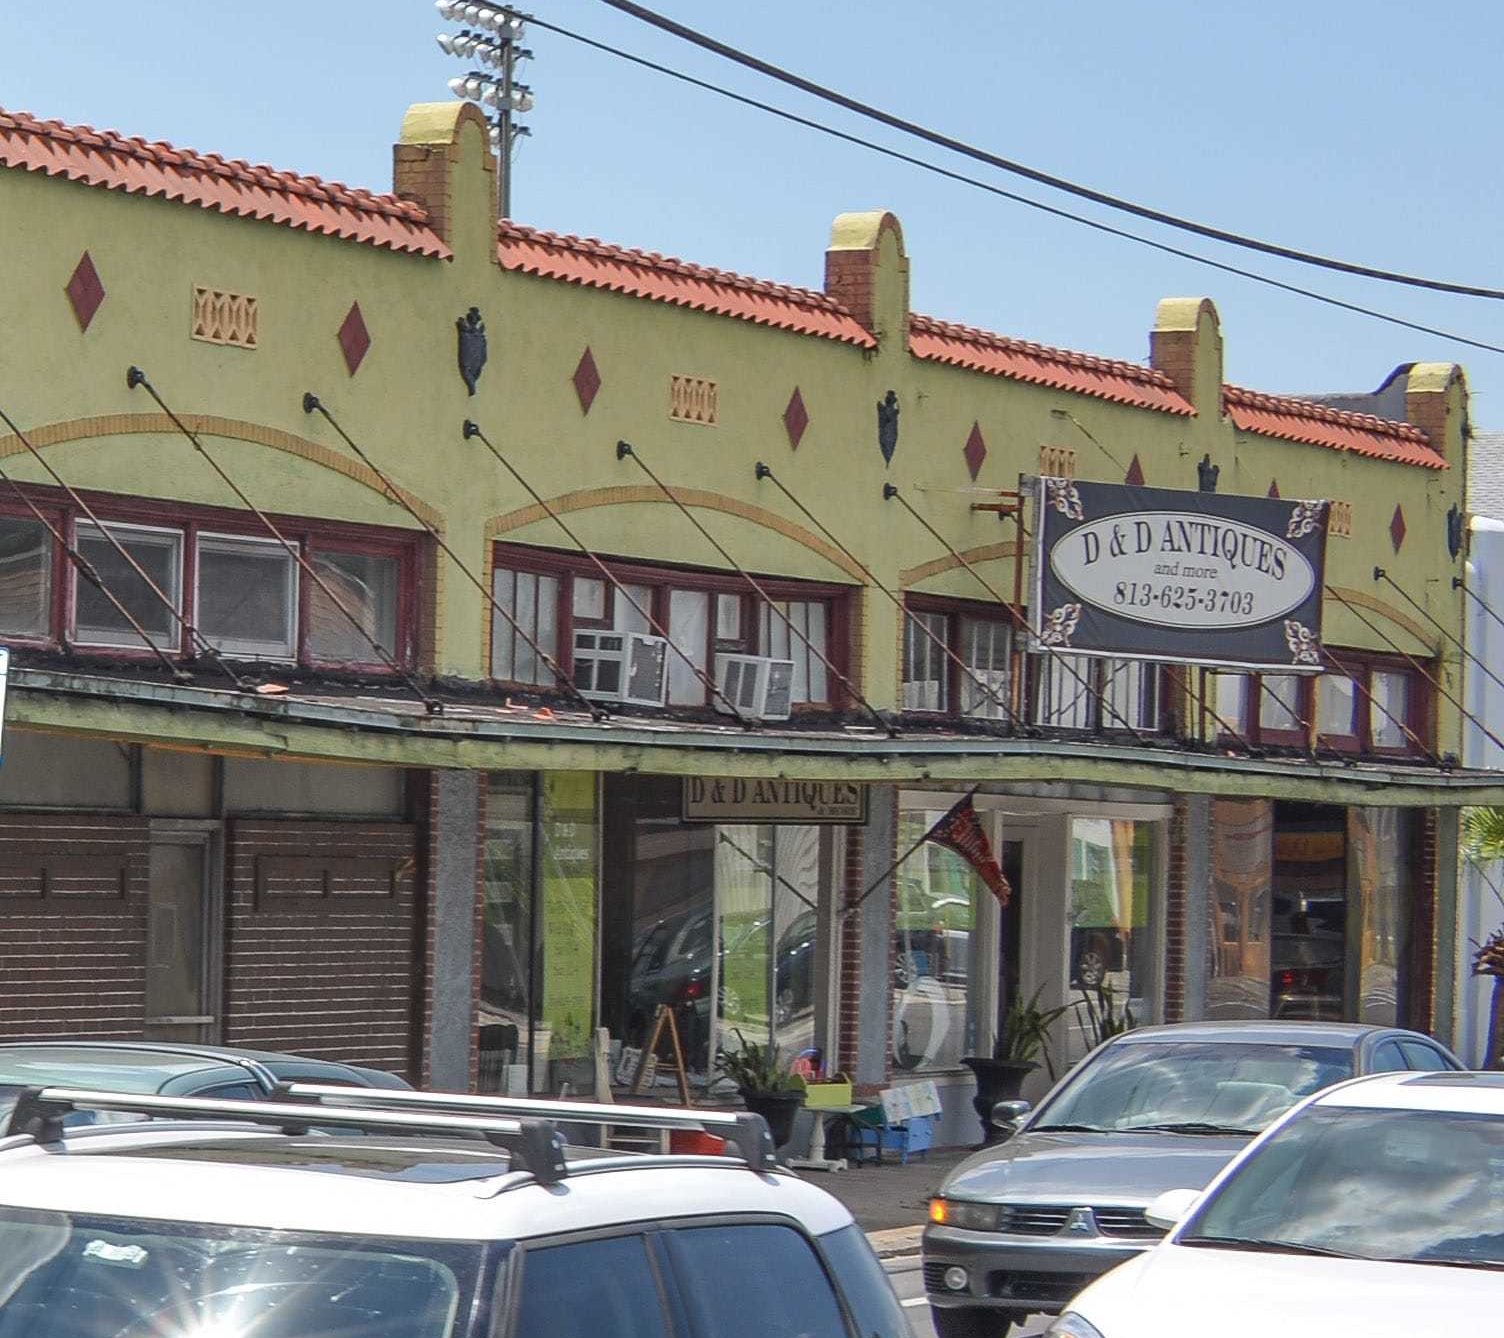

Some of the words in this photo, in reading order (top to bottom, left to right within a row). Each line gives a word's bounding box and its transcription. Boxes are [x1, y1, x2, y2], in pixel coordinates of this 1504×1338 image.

[1082, 530, 1101, 566] D
[1109, 523, 1127, 559] &
[1134, 520, 1152, 554] D
[1159, 520, 1288, 581] ANTIQUES
[1153, 561, 1179, 577] and
[1182, 564, 1218, 580] more
[751, 779, 859, 810] ANTIQUES
